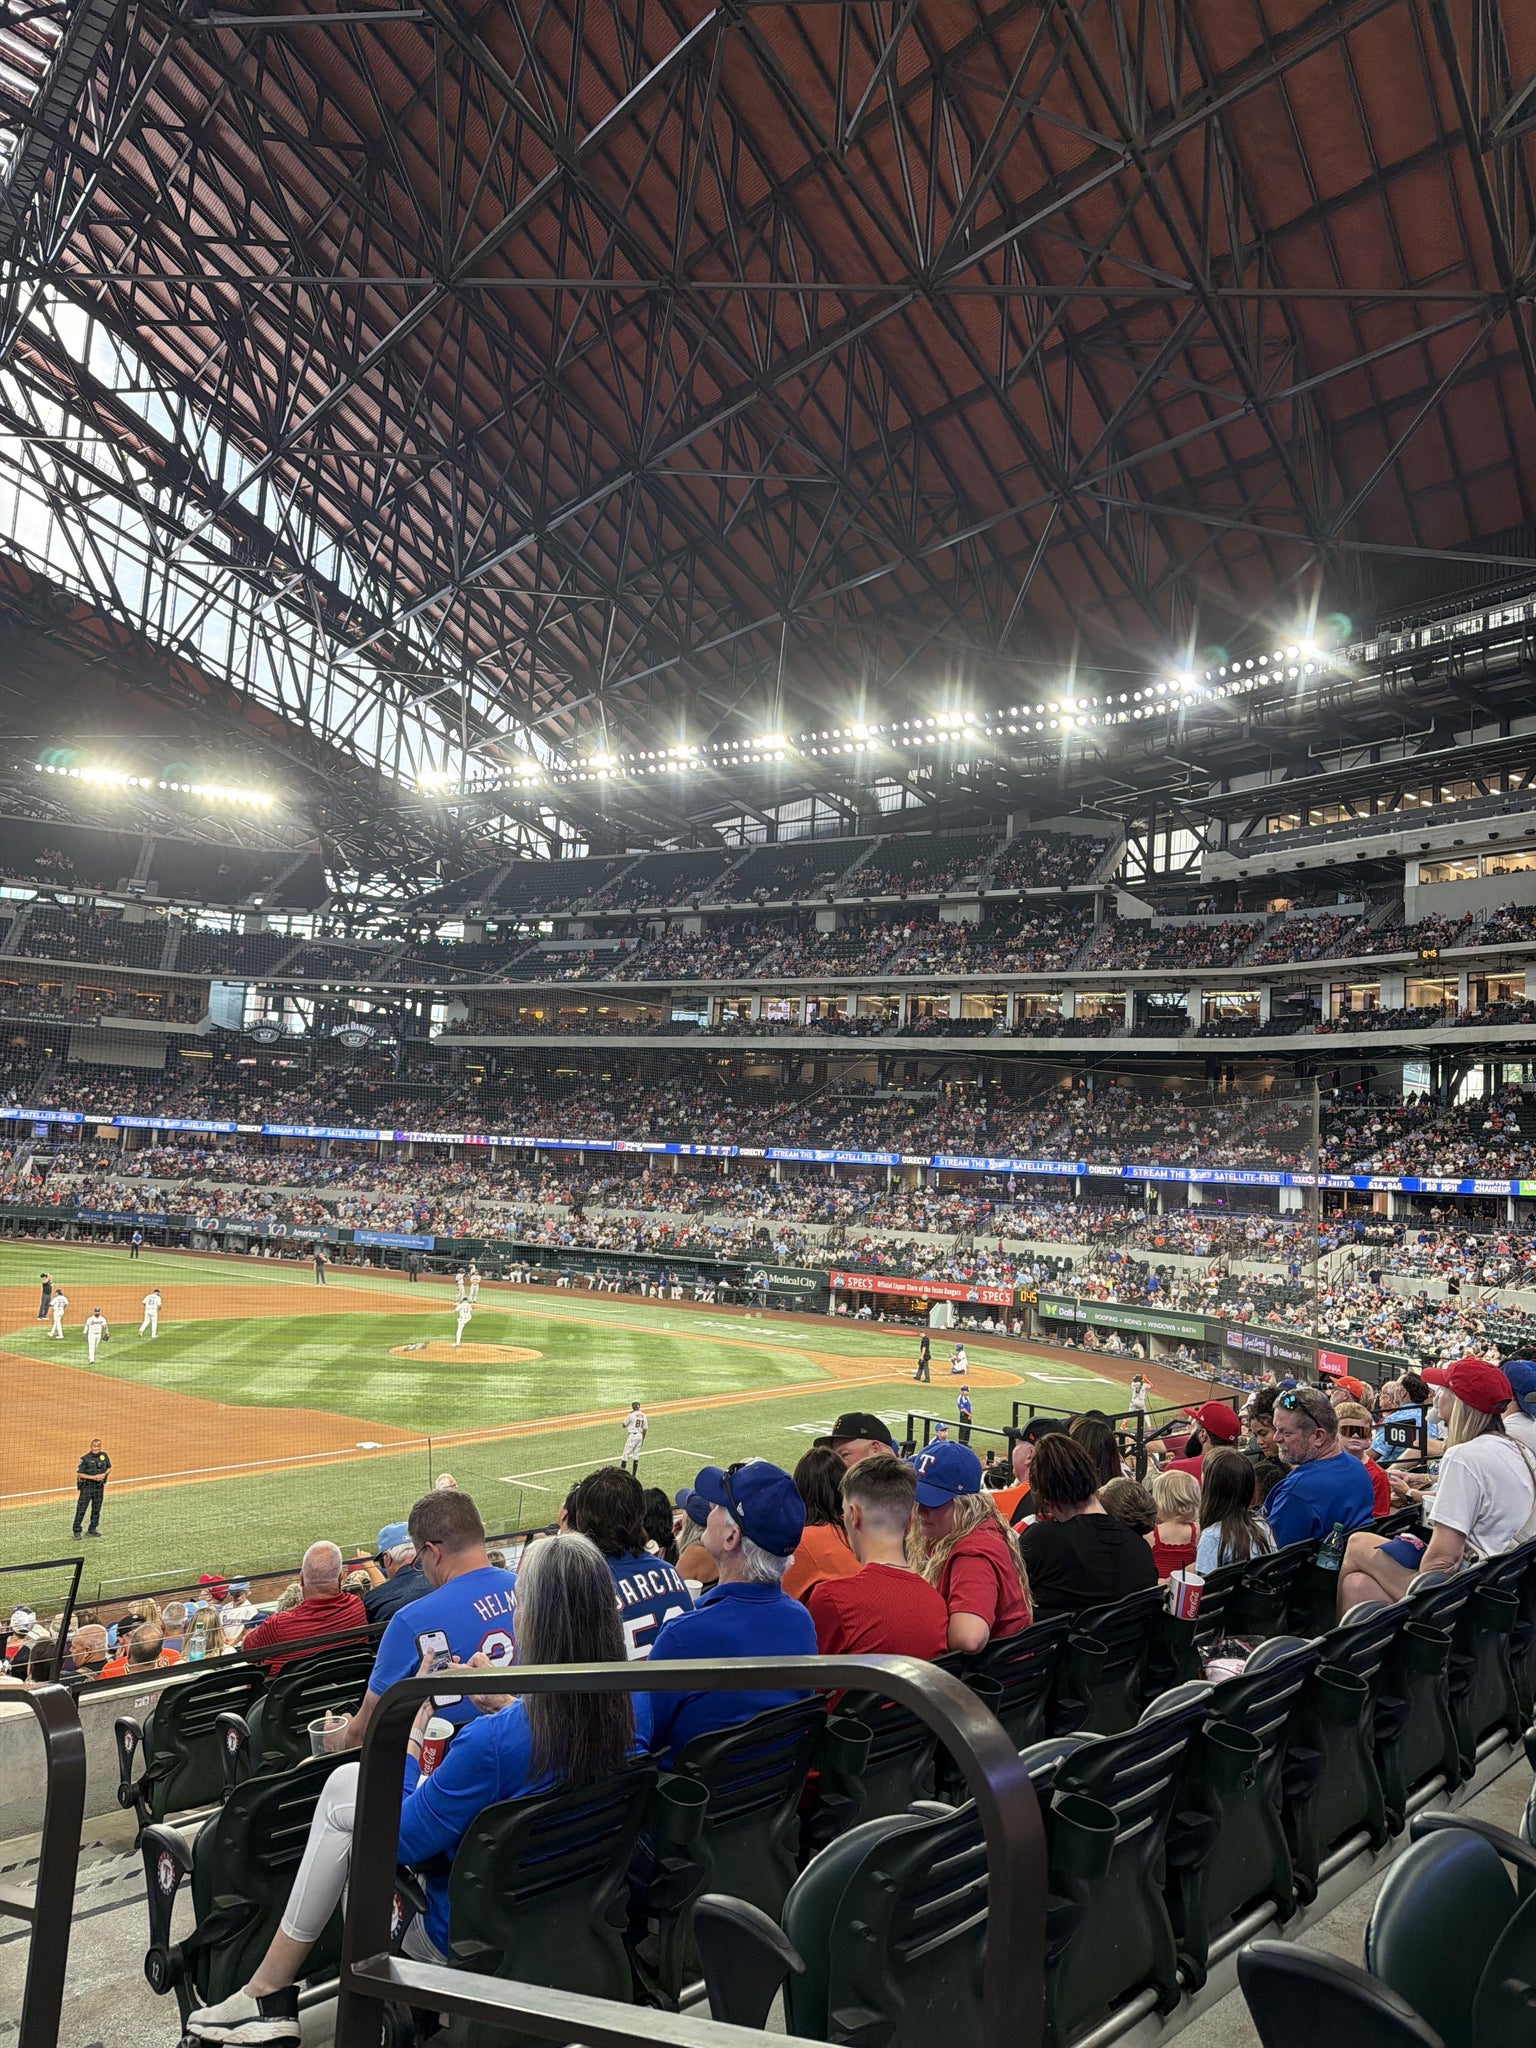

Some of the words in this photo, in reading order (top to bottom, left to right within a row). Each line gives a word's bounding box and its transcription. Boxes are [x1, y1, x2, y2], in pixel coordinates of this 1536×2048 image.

[333, 1023, 350, 1036] JACK
[772, 1149, 799, 1158] STREAM
[800, 1150, 813, 1159] THE
[836, 1152, 893, 1164] SATELLITE-FREE
[901, 1155, 932, 1165] DIRECTV
[939, 1157, 970, 1168] STREAM
[971, 1159, 986, 1169] THE
[1012, 1161, 1079, 1174] SATELLITE-FREE
[1088, 1165, 1123, 1176] DIRECTV
[1132, 1168, 1168, 1179] STREAM
[1170, 1169, 1187, 1180] THE
[1214, 1171, 1281, 1184] SATELLITE-FREE
[1441, 1183, 1458, 1193] MPH
[1474, 1185, 1511, 1194] CHANGEUP
[225, 1222, 252, 1233] American
[292, 1228, 321, 1238] American
[768, 1273, 800, 1286] Medical
[800, 1277, 818, 1289] City
[847, 1276, 873, 1289] SPEC'S
[877, 1281, 893, 1290] Official
[893, 1282, 906, 1292] Liquor
[906, 1284, 918, 1292] Store
[931, 1286, 943, 1294] Texas
[943, 1287, 962, 1297] Rangers
[982, 1290, 1011, 1303] SPEC'S
[1094, 1313, 1118, 1323] ROOFING
[1123, 1317, 1142, 1327] SIDING
[1147, 1321, 1176, 1332] WINDOWS
[1181, 1325, 1197, 1334] BATH
[1278, 1347, 1292, 1359] Globe
[1292, 1350, 1302, 1361] Life
[1302, 1352, 1313, 1364] Field
[1390, 1427, 1406, 1443] 06
[918, 1453, 936, 1476] T
[615, 1567, 686, 1611] ARCIA
[151, 1961, 160, 1981] 12
